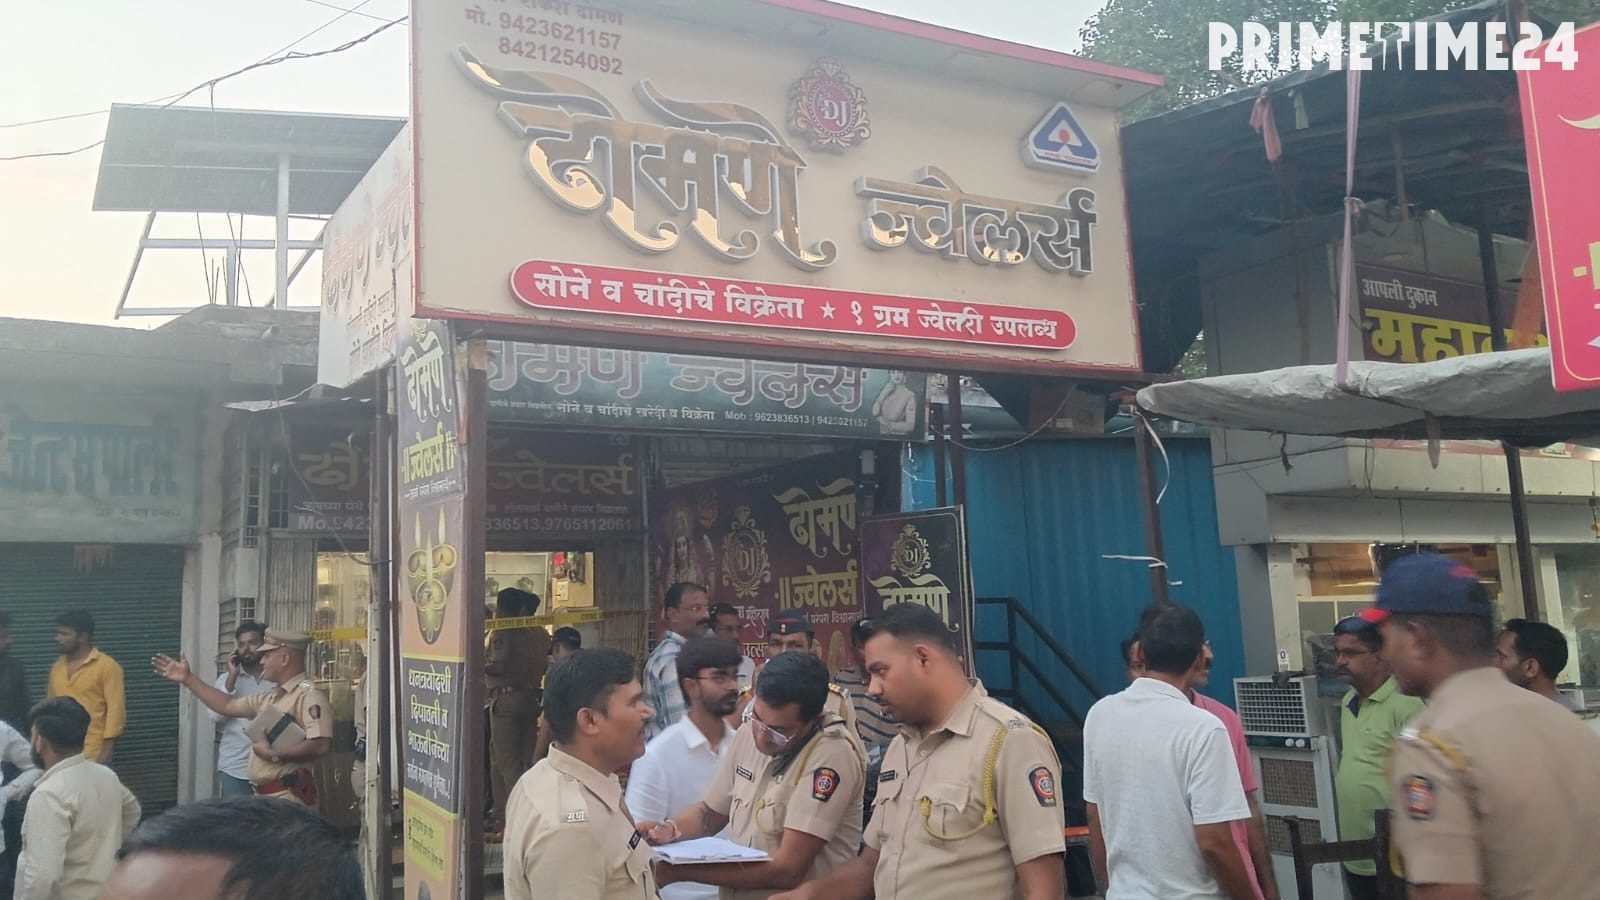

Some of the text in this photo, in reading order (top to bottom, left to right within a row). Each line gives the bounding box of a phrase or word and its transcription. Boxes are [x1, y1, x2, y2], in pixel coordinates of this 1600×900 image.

[464, 5, 622, 50] मो. 9423621157
[498, 37, 623, 75] 8421254092
[855, 164, 1097, 277] ज्वेलर्स
[533, 265, 592, 300] सोने
[601, 279, 624, 304] व
[632, 277, 716, 314] चांदीचे
[723, 284, 805, 320] विक्रेता
[850, 299, 864, 326] १
[872, 305, 910, 329] ग्रम
[990, 316, 1058, 340] उपलब्ध
[1362, 279, 1439, 309] आपली दुकान
[584, 404, 594, 415] व
[597, 402, 633, 418] चांदीचे
[669, 408, 678, 418] व
[681, 406, 716, 422] विक्रेता
[755, 412, 810, 424] 9623836513
[743, 641, 769, 658] उत्स
[408, 663, 453, 696] धनत्रयोदशी
